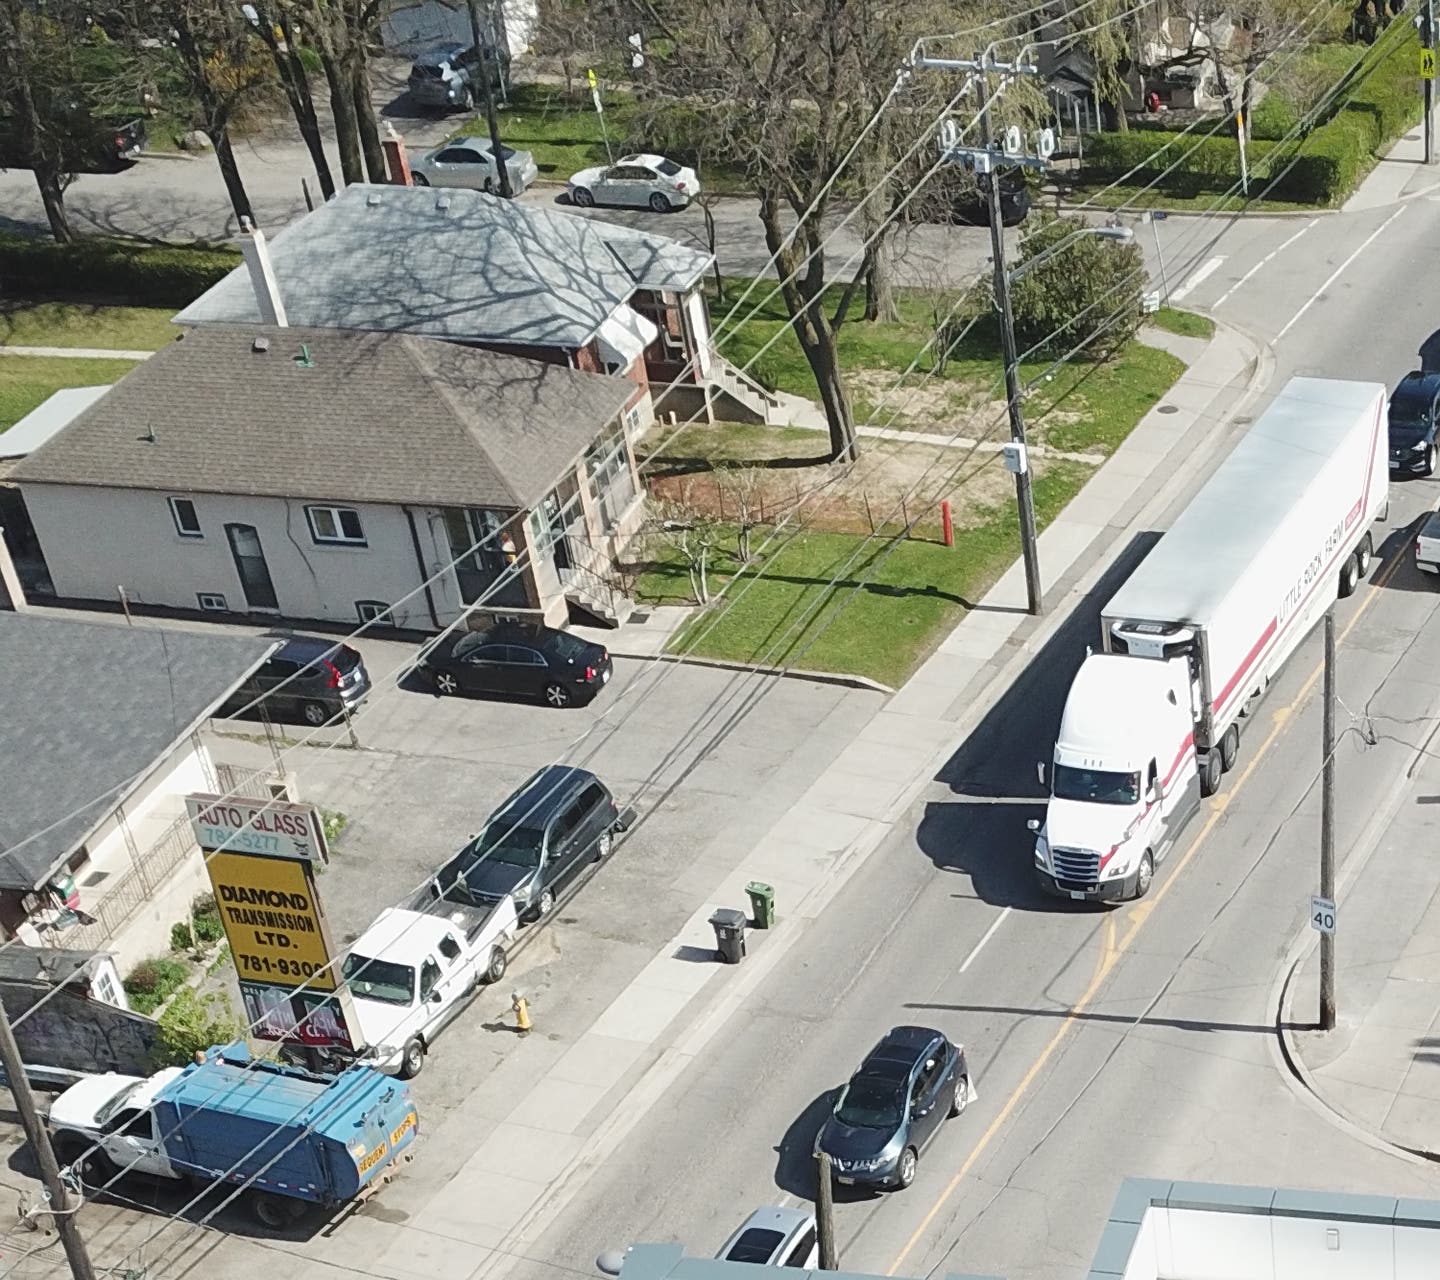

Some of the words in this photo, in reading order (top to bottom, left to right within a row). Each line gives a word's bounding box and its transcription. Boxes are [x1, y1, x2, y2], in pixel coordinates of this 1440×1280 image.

[197, 804, 243, 828] AUTO
[249, 810, 308, 836] GLASS
[219, 884, 308, 911] DIAMOND
[226, 907, 314, 933] TRANSMISSION
[1313, 912, 1333, 928] 40
[254, 931, 298, 949] LTD.
